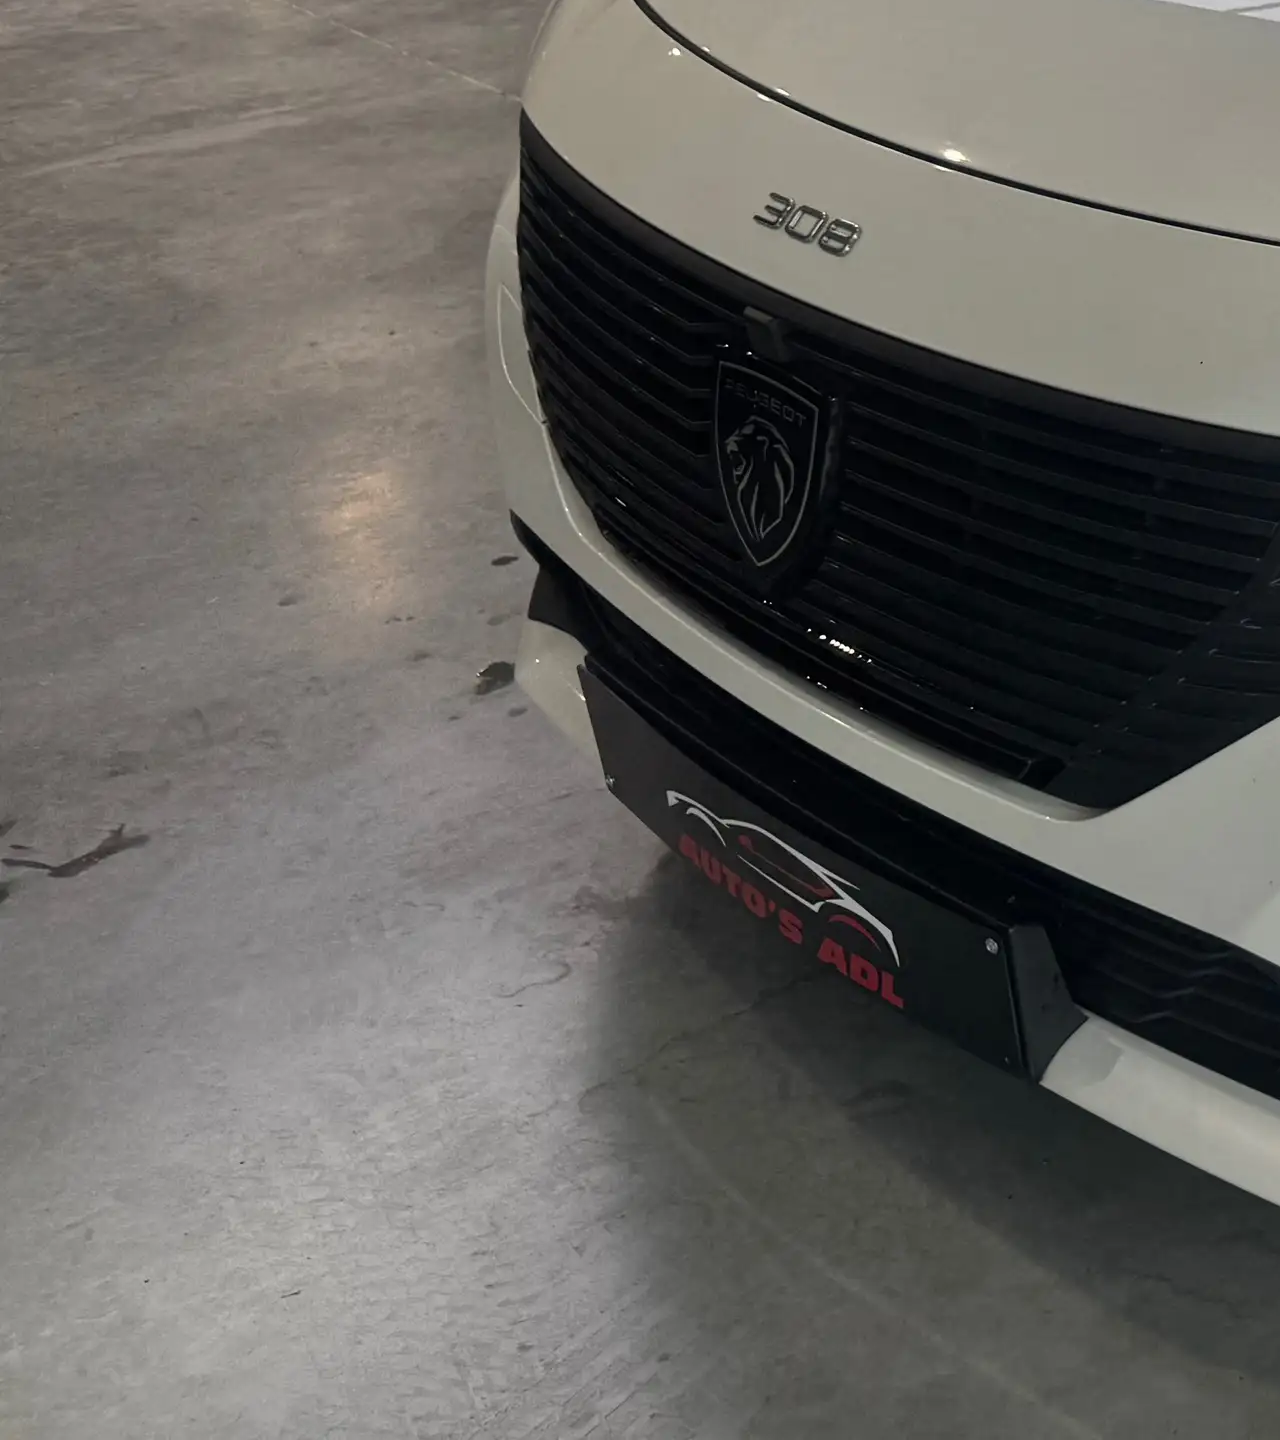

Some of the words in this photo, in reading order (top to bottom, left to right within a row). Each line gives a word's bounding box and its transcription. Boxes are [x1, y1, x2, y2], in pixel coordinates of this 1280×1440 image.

[753, 192, 862, 257] 308
[724, 377, 807, 428] PEUGEOT
[678, 834, 803, 945] AUTO'S
[817, 937, 905, 1009] ADL
